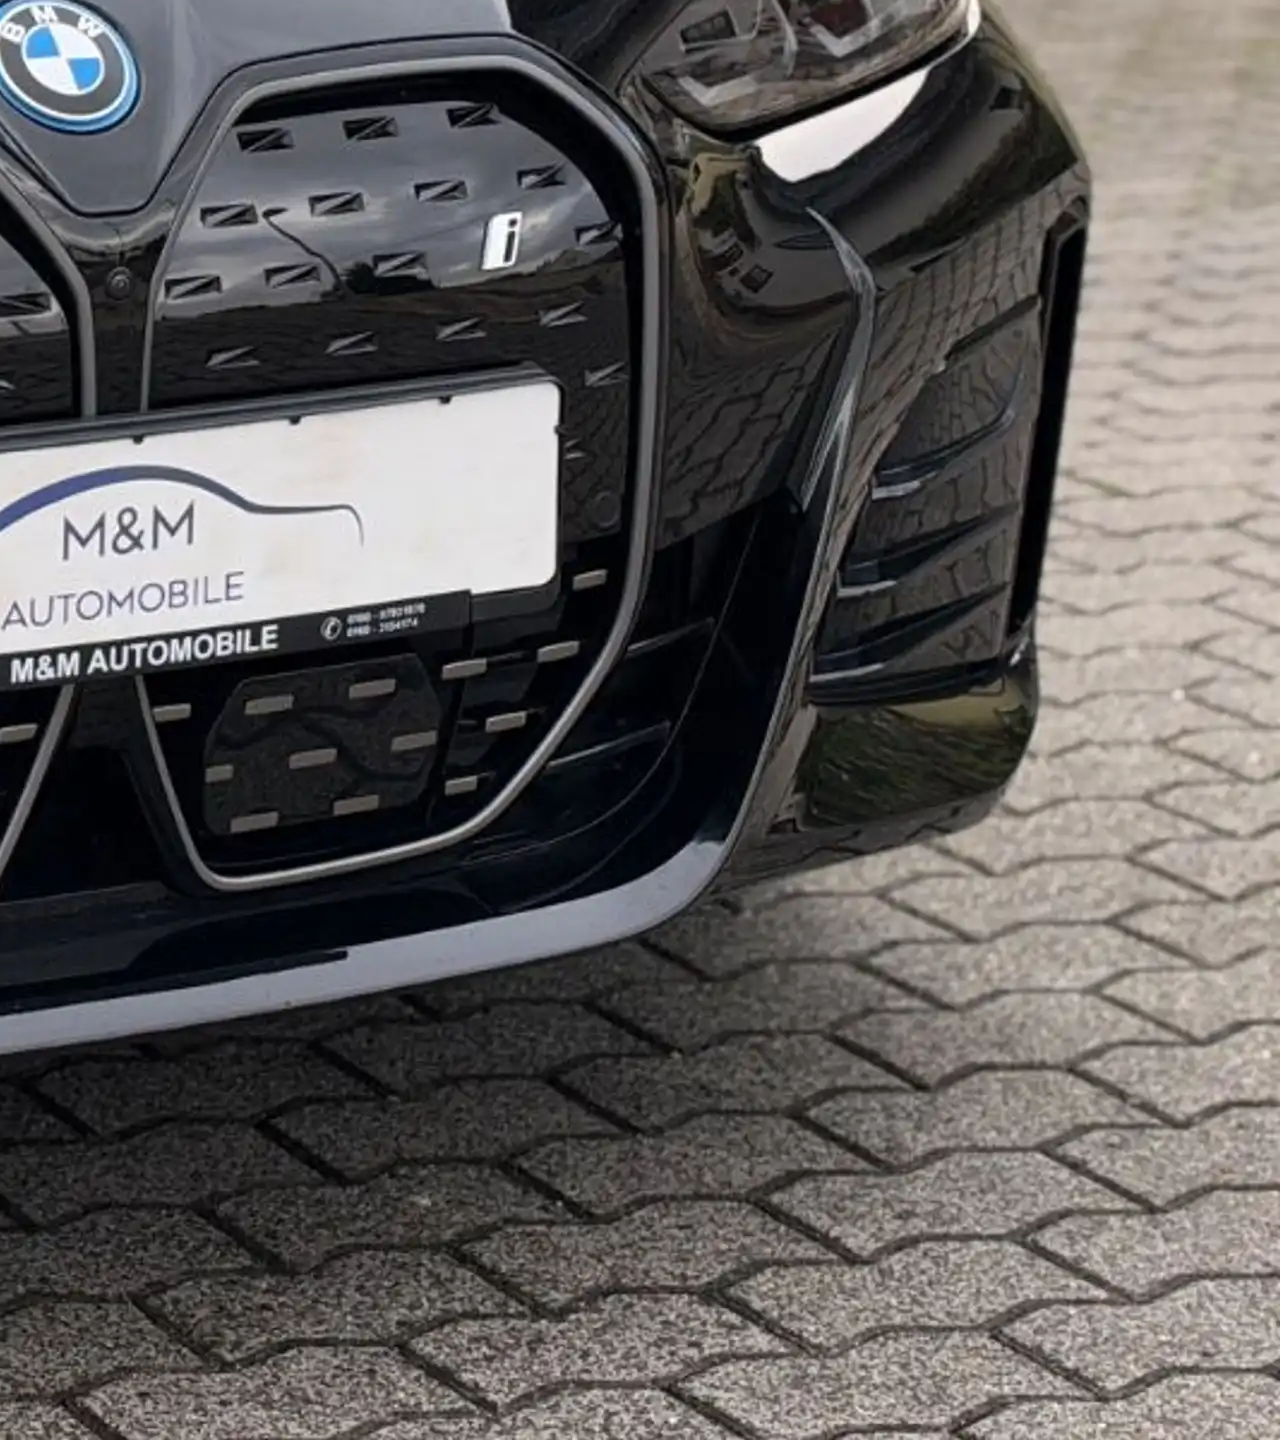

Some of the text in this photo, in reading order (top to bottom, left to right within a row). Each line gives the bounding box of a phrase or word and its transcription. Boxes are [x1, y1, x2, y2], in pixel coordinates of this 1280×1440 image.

[0, 4, 106, 45] BMW
[61, 500, 195, 561] M&M
[1, 570, 245, 631] AUTOMOBILE
[10, 652, 81, 685] M&M
[87, 623, 280, 676] AUTOMOBILE
